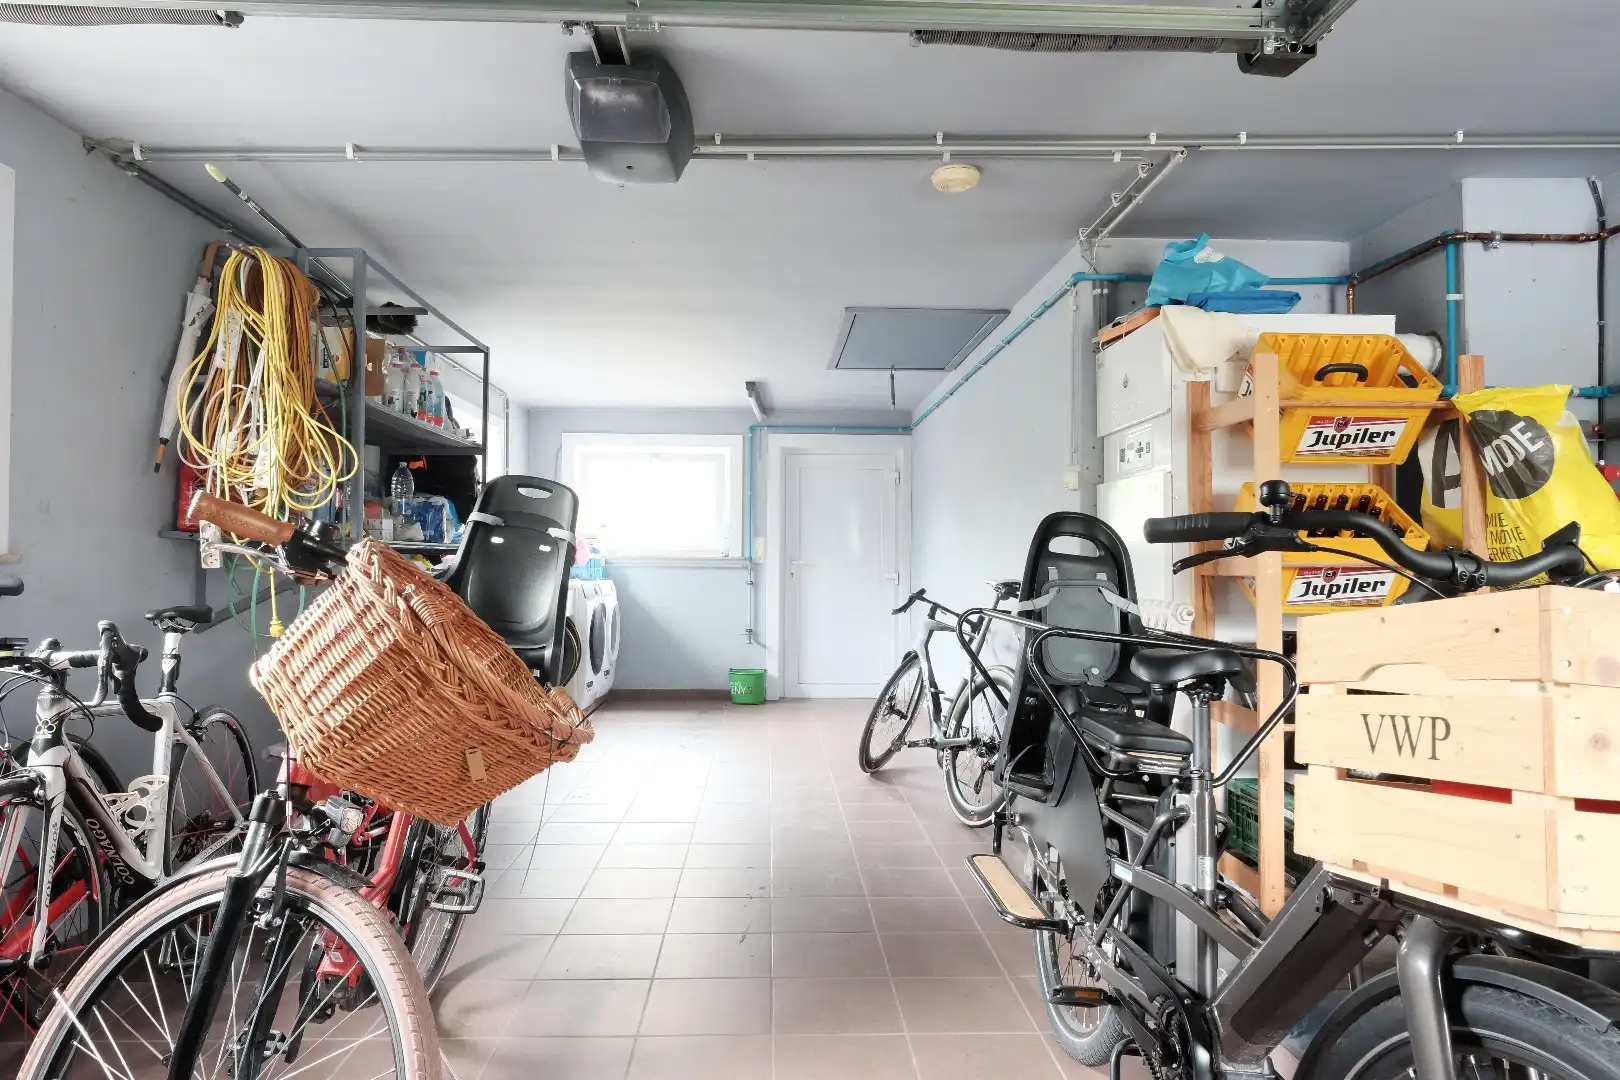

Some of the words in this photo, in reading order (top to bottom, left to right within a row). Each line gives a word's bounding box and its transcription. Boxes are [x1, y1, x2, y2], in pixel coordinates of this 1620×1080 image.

[1306, 427, 1396, 449] Jupiler
[1295, 577, 1386, 599] Jupiler
[1360, 713, 1451, 760] VWP
[85, 818, 135, 885] COLNAGO
